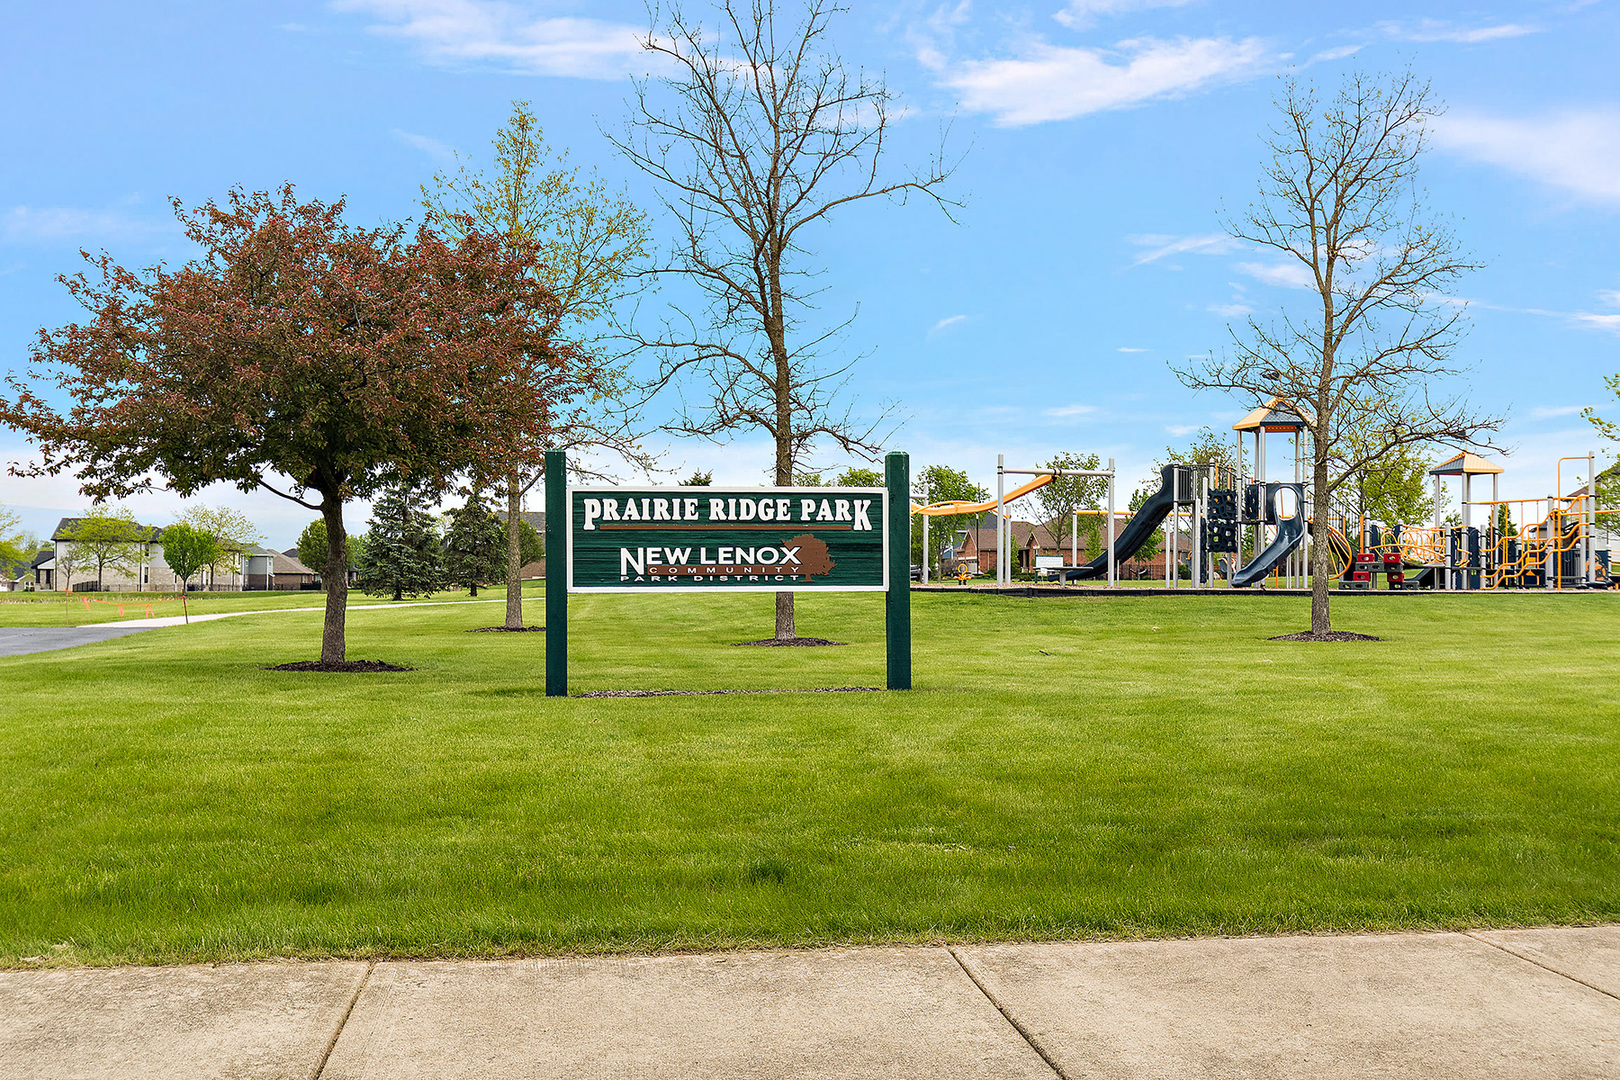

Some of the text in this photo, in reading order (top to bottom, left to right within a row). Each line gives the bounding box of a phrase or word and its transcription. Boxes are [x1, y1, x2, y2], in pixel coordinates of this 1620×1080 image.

[583, 498, 872, 531] PRAIRIE RIDGE PARK
[620, 547, 803, 575] NEW LENOX
[648, 566, 800, 574] COMMUNITY
